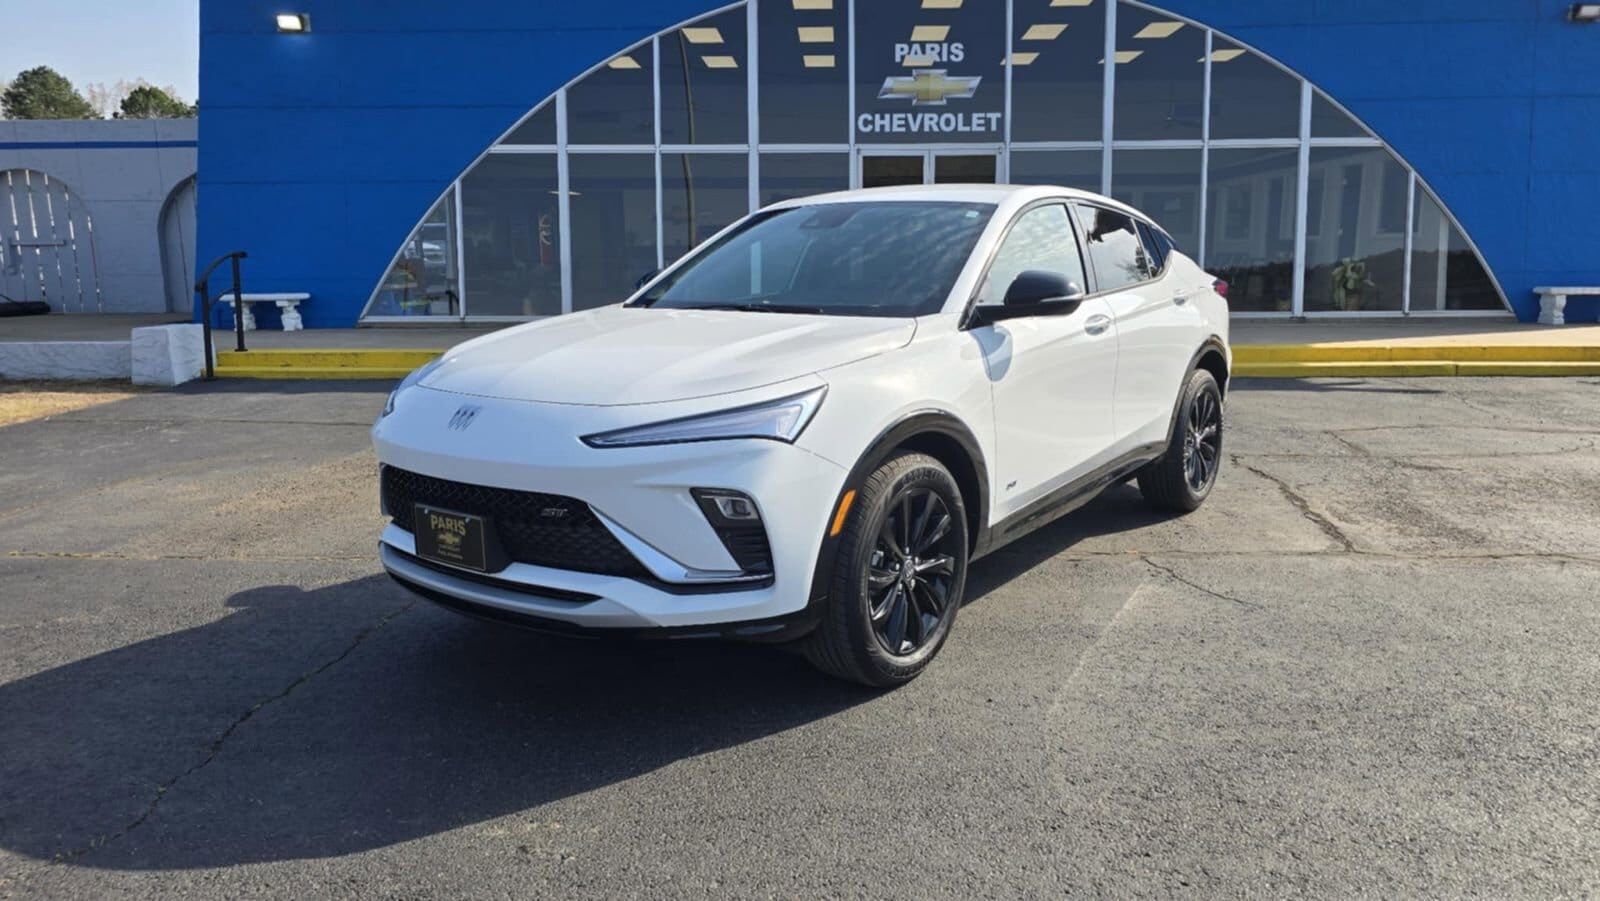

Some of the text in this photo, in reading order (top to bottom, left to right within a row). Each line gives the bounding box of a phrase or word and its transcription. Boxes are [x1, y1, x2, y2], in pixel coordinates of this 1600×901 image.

[895, 43, 964, 62] PARIS
[857, 112, 1001, 133] CHEVROLET
[430, 514, 466, 536] PARIS
